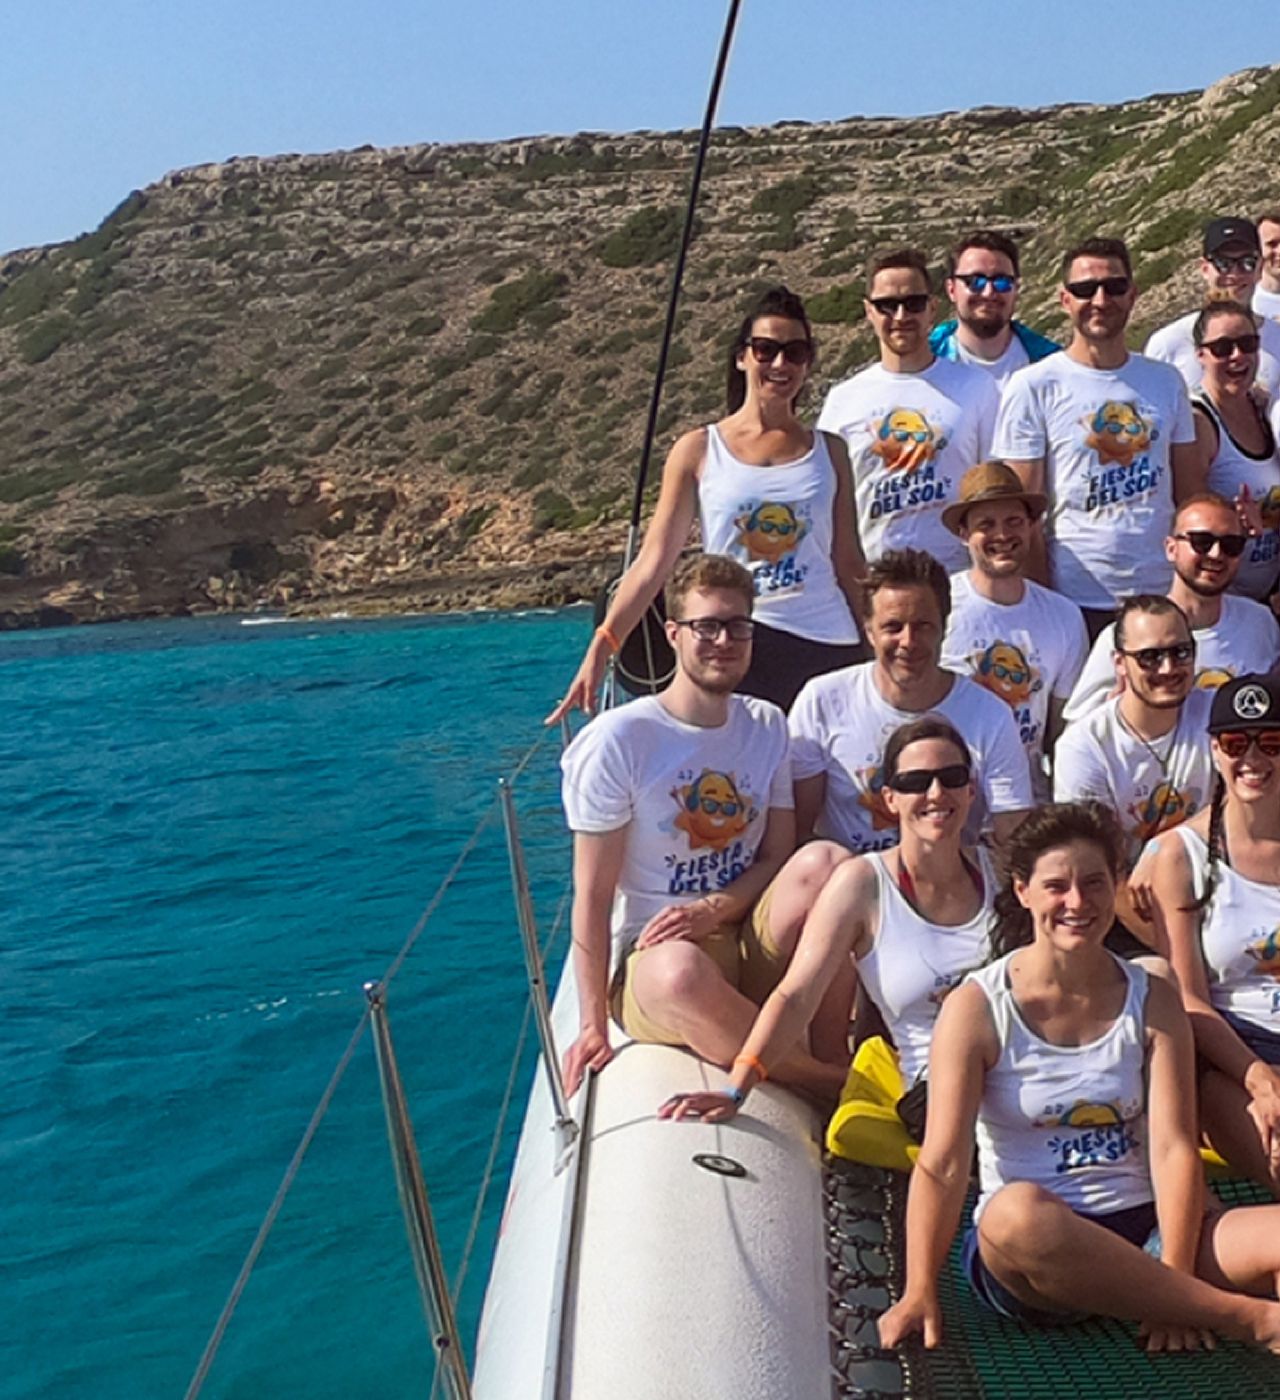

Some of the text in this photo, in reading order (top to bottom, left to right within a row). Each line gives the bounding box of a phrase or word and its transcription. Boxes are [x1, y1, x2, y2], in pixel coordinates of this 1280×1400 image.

[873, 466, 935, 497] FIESTA
[1087, 474, 1158, 512] DEL SOL
[1089, 457, 1149, 493] FIESTA
[870, 490, 902, 519] DEL
[907, 483, 946, 505] SOL
[675, 843, 742, 880] FIESTA
